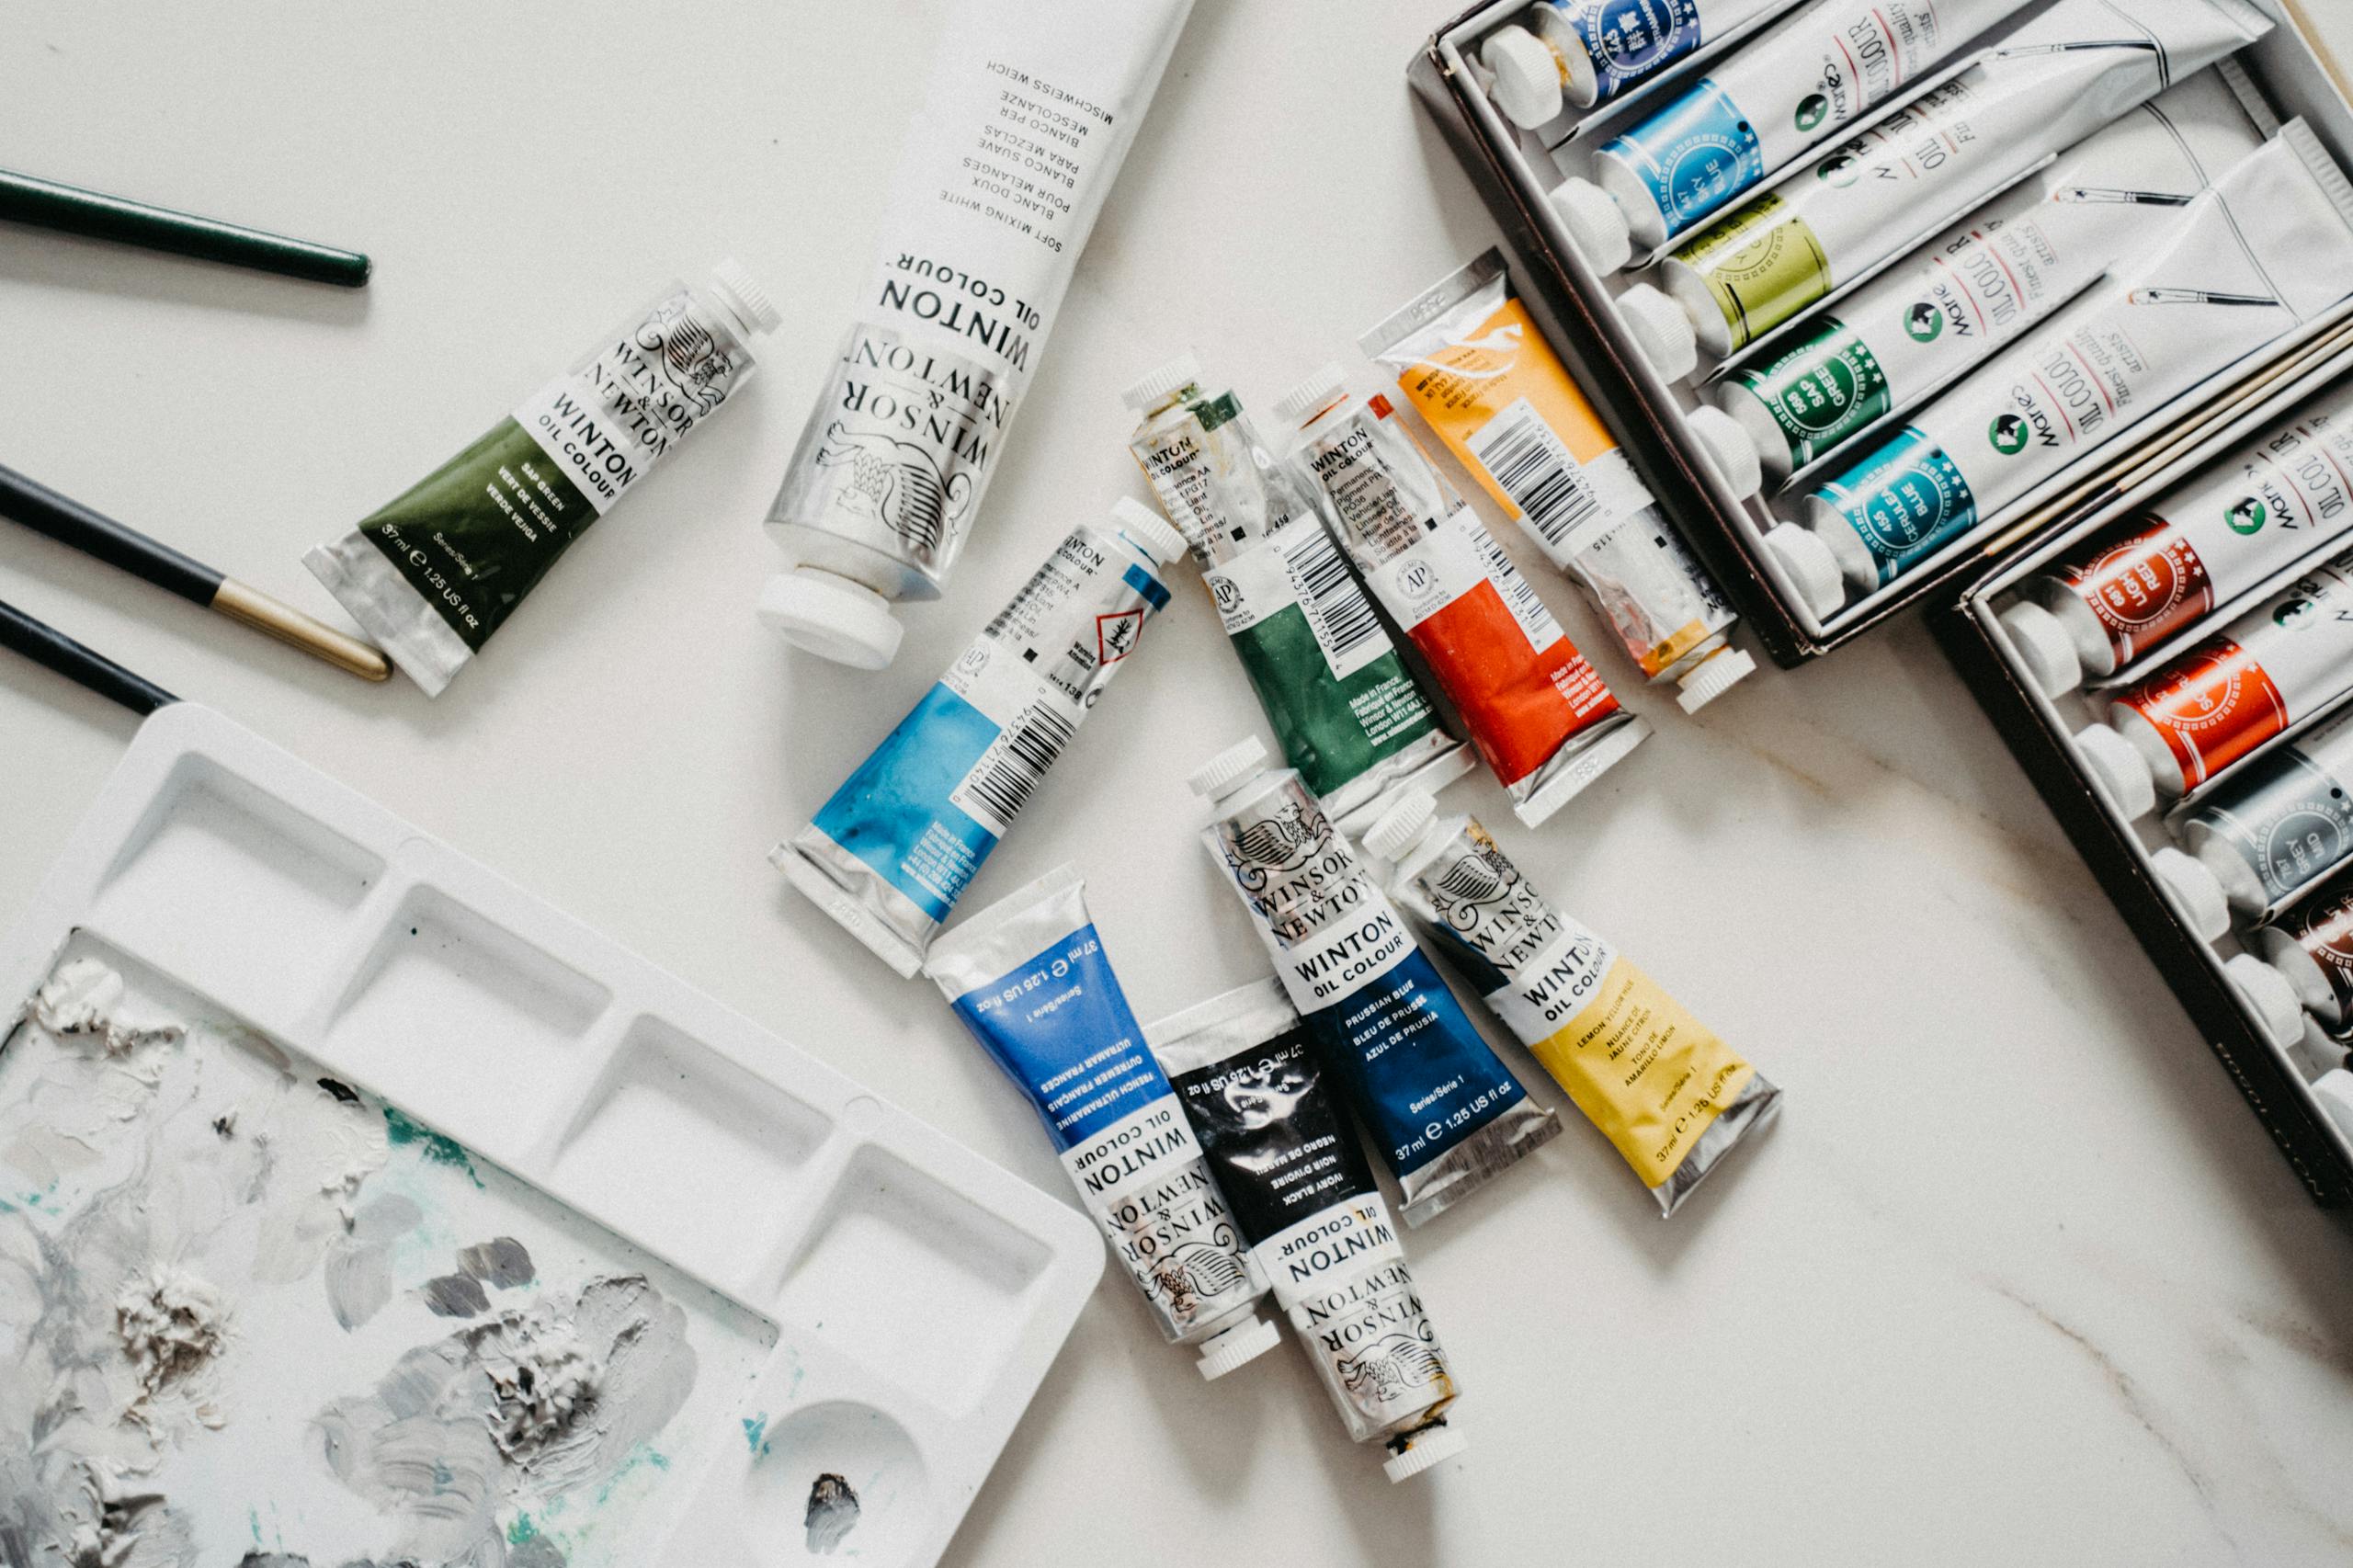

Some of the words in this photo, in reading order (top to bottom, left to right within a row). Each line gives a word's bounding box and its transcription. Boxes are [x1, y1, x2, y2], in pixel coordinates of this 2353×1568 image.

[986, 59, 1029, 84] WEICH
[999, 90, 1088, 135] MESCOLANZE
[999, 106, 1027, 123] PER
[1031, 78, 1114, 124] MISCHWEISS
[983, 124, 1045, 156] MEZCLAS
[1029, 118, 1080, 148] BIANCO
[976, 137, 1020, 162] SUAVE
[1047, 151, 1079, 174] PARA
[1915, 137, 1947, 169] OIL
[961, 156, 1034, 192] MELANGES
[971, 176, 1009, 198] DOUX
[1023, 155, 1074, 187] BLANCO
[1705, 159, 1723, 193] BLUE
[938, 188, 982, 212] WHITE
[1036, 187, 1070, 212] POUR
[1691, 176, 1708, 201] SKY
[983, 205, 1032, 234] MIXING
[1011, 192, 1055, 220] BLANC
[1032, 229, 1063, 253] SOFT
[896, 253, 1006, 308] COLOUR
[878, 278, 1028, 372] WINTON
[1010, 300, 1040, 331] OIL
[1993, 293, 2015, 325] OIL
[610, 339, 696, 437] WINSOR
[854, 335, 1010, 428] NEWTON
[1800, 382, 1824, 406] SAP
[2105, 366, 2131, 407] Finest
[585, 362, 671, 458] NEWTON
[636, 393, 654, 411] &
[923, 389, 945, 411] &
[843, 377, 992, 471] WINSOR
[2078, 402, 2103, 433] OIL
[551, 391, 638, 487] WINTON
[1310, 427, 1369, 473] WINTON
[1534, 423, 1566, 460] 71136
[537, 413, 564, 441] OIL
[562, 440, 617, 501] COLOUR
[1321, 467, 1337, 482] OIL
[1337, 441, 1373, 470] COLOUR
[520, 461, 540, 483] SAP
[536, 480, 565, 512] GREEN
[1336, 480, 1370, 507] Pigment
[1563, 460, 1597, 498] 94376
[484, 483, 514, 515] VERDE
[510, 511, 538, 542] VEJIGA
[496, 465, 520, 491] VERT
[516, 488, 530, 504] DE
[528, 501, 557, 532] VESSIE
[1342, 494, 1367, 515] PO36
[1348, 485, 1397, 523] Vehicle/Liant
[1880, 487, 1918, 541] CERULEA
[1900, 482, 1928, 516] BLUE
[2317, 486, 2344, 517] OIL
[1355, 506, 1387, 531] Linseed
[1361, 521, 1383, 540] Huile
[1381, 514, 1394, 525] de
[1392, 505, 1405, 517] Lin
[1873, 510, 1892, 530] 455
[1373, 532, 1403, 556] Solidité
[1378, 541, 1408, 565] lumière
[1591, 533, 1612, 551] 115
[380, 521, 399, 541] 37
[423, 565, 447, 590] 1.25
[441, 585, 462, 608] US
[1402, 565, 1430, 592] AP
[2134, 562, 2161, 589] RED
[1211, 582, 1235, 606] AP
[2105, 585, 2124, 606] 681
[2118, 573, 2147, 606] LIGH
[1285, 566, 1313, 606] 94376
[1308, 608, 1334, 648] 71155
[1066, 649, 1092, 671] Attention
[1072, 641, 1097, 664] Warning
[1063, 682, 1083, 700] 138
[1348, 691, 1370, 709] Made
[1359, 707, 1387, 728] Winsor
[1391, 689, 1416, 709] Newton
[1364, 716, 1393, 737] London
[1391, 707, 1408, 722] W11
[999, 706, 1032, 744] 94376
[969, 745, 1002, 784] 71140
[2285, 838, 2310, 873] GREY
[2307, 833, 2325, 858] MID
[1254, 847, 1352, 918] WINSOR
[1308, 887, 1324, 903] &
[1271, 873, 1368, 947] NEWTON
[1067, 947, 1083, 963] ml
[1080, 938, 1097, 955] 37
[1294, 911, 1392, 983] WINTON
[1021, 969, 1049, 990] 1.25
[1313, 977, 1339, 998] OIL
[1341, 936, 1403, 983] COLOUR
[1522, 931, 1593, 1007] WINTON
[1002, 984, 1022, 1002] US
[1543, 995, 1572, 1022] OIL
[1571, 948, 1607, 997] COLOUR
[1345, 994, 1392, 1028] PRUSSIAN
[1392, 979, 1415, 999] BLUE
[1352, 1025, 1378, 1046] BLEU
[1377, 1016, 1392, 1029] DE
[1392, 994, 1427, 1021] PRUSSE
[1364, 1040, 1389, 1062] AZUL
[1388, 1031, 1404, 1045] DE
[1403, 1010, 1438, 1036] PRUSIA
[1576, 1021, 1606, 1049] LEMON
[1606, 994, 1626, 1023] YELLOW
[1606, 1016, 1634, 1048] NUANCE
[1608, 1034, 1633, 1061] JAUNE
[1631, 1007, 1651, 1035] CITRON
[1084, 1038, 1131, 1068] ULTRAMAR
[1623, 1048, 1658, 1086] AMARILLO
[1631, 1042, 1651, 1064] TONO
[1093, 1054, 1142, 1085] OUTREMER
[1119, 1072, 1154, 1095] FRENCH
[1210, 1074, 1228, 1091] US
[1228, 1064, 1254, 1083] 1.25
[1046, 1080, 1094, 1112] FRANÇAIS
[1055, 1089, 1120, 1130] ULTRAMARINE
[1408, 1078, 1458, 1114] Series/Série
[1144, 1109, 1171, 1130] OIL
[1393, 1143, 1413, 1161] 37
[1409, 1135, 1426, 1152] ml
[1444, 1107, 1471, 1130] 1.25
[1468, 1095, 1489, 1114] US
[1496, 1080, 1512, 1095] oz
[1655, 1145, 1672, 1163] 37
[1707, 1081, 1723, 1099] US
[1074, 1125, 1142, 1169] COLOUR
[1287, 1147, 1302, 1160] DE
[1302, 1133, 1335, 1153] NEGRO
[1084, 1127, 1186, 1195] WINTON
[1269, 1164, 1312, 1189] D'IVOIRE
[1312, 1153, 1336, 1171] NOIR
[1282, 1184, 1314, 1205] BLACK
[1314, 1171, 1343, 1191] IVORY
[1106, 1165, 1208, 1234] NEWTON
[1156, 1208, 1172, 1223] &
[1356, 1205, 1376, 1221] OIL
[1120, 1196, 1224, 1263] WINSOR
[1280, 1213, 1352, 1256] COLOUR
[1288, 1221, 1392, 1282] WINTON
[1305, 1262, 1411, 1325] NEWTON
[1365, 1297, 1380, 1312] &
[1320, 1293, 1423, 1352] WINSOR
